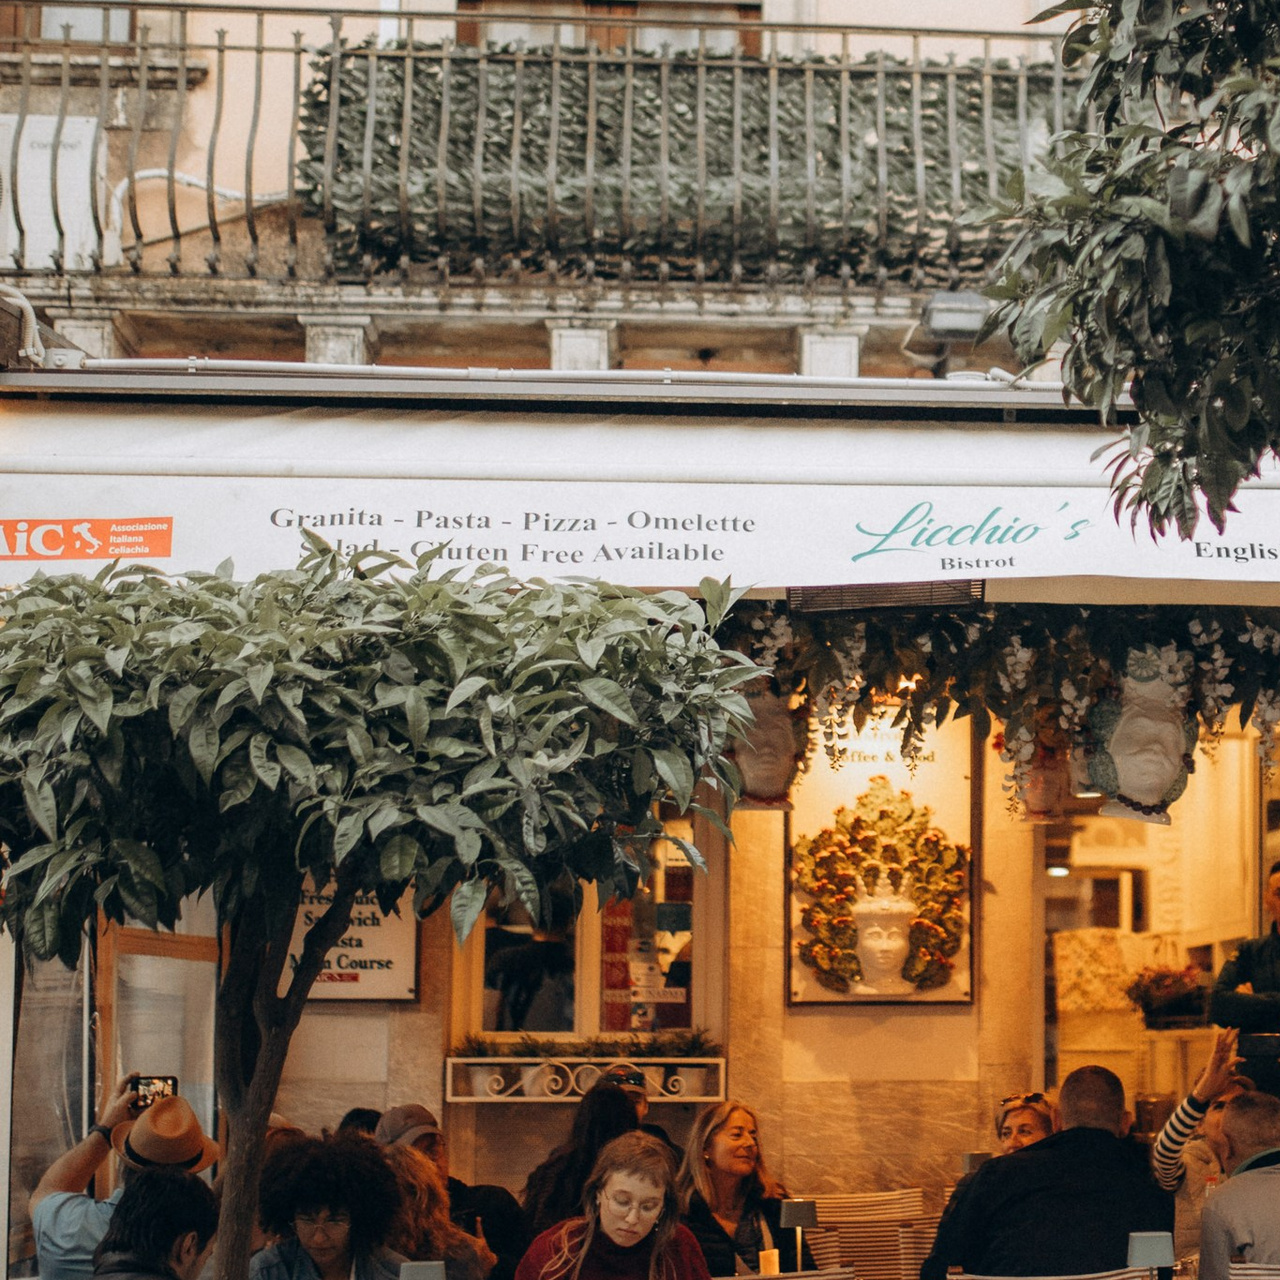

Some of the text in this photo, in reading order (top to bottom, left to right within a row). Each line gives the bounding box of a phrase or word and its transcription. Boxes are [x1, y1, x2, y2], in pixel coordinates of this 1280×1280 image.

[110, 522, 168, 532] Associazione
[270, 507, 384, 529] Granita
[415, 509, 492, 530] Pasta
[522, 511, 598, 532] Pizza
[626, 510, 756, 533] Omelette
[109, 535, 144, 544] Italiana
[108, 545, 150, 555] Celiachia
[521, 543, 584, 564] Free
[592, 541, 725, 563] Available
[940, 555, 1016, 571] Bistrot
[336, 953, 394, 970] Course
